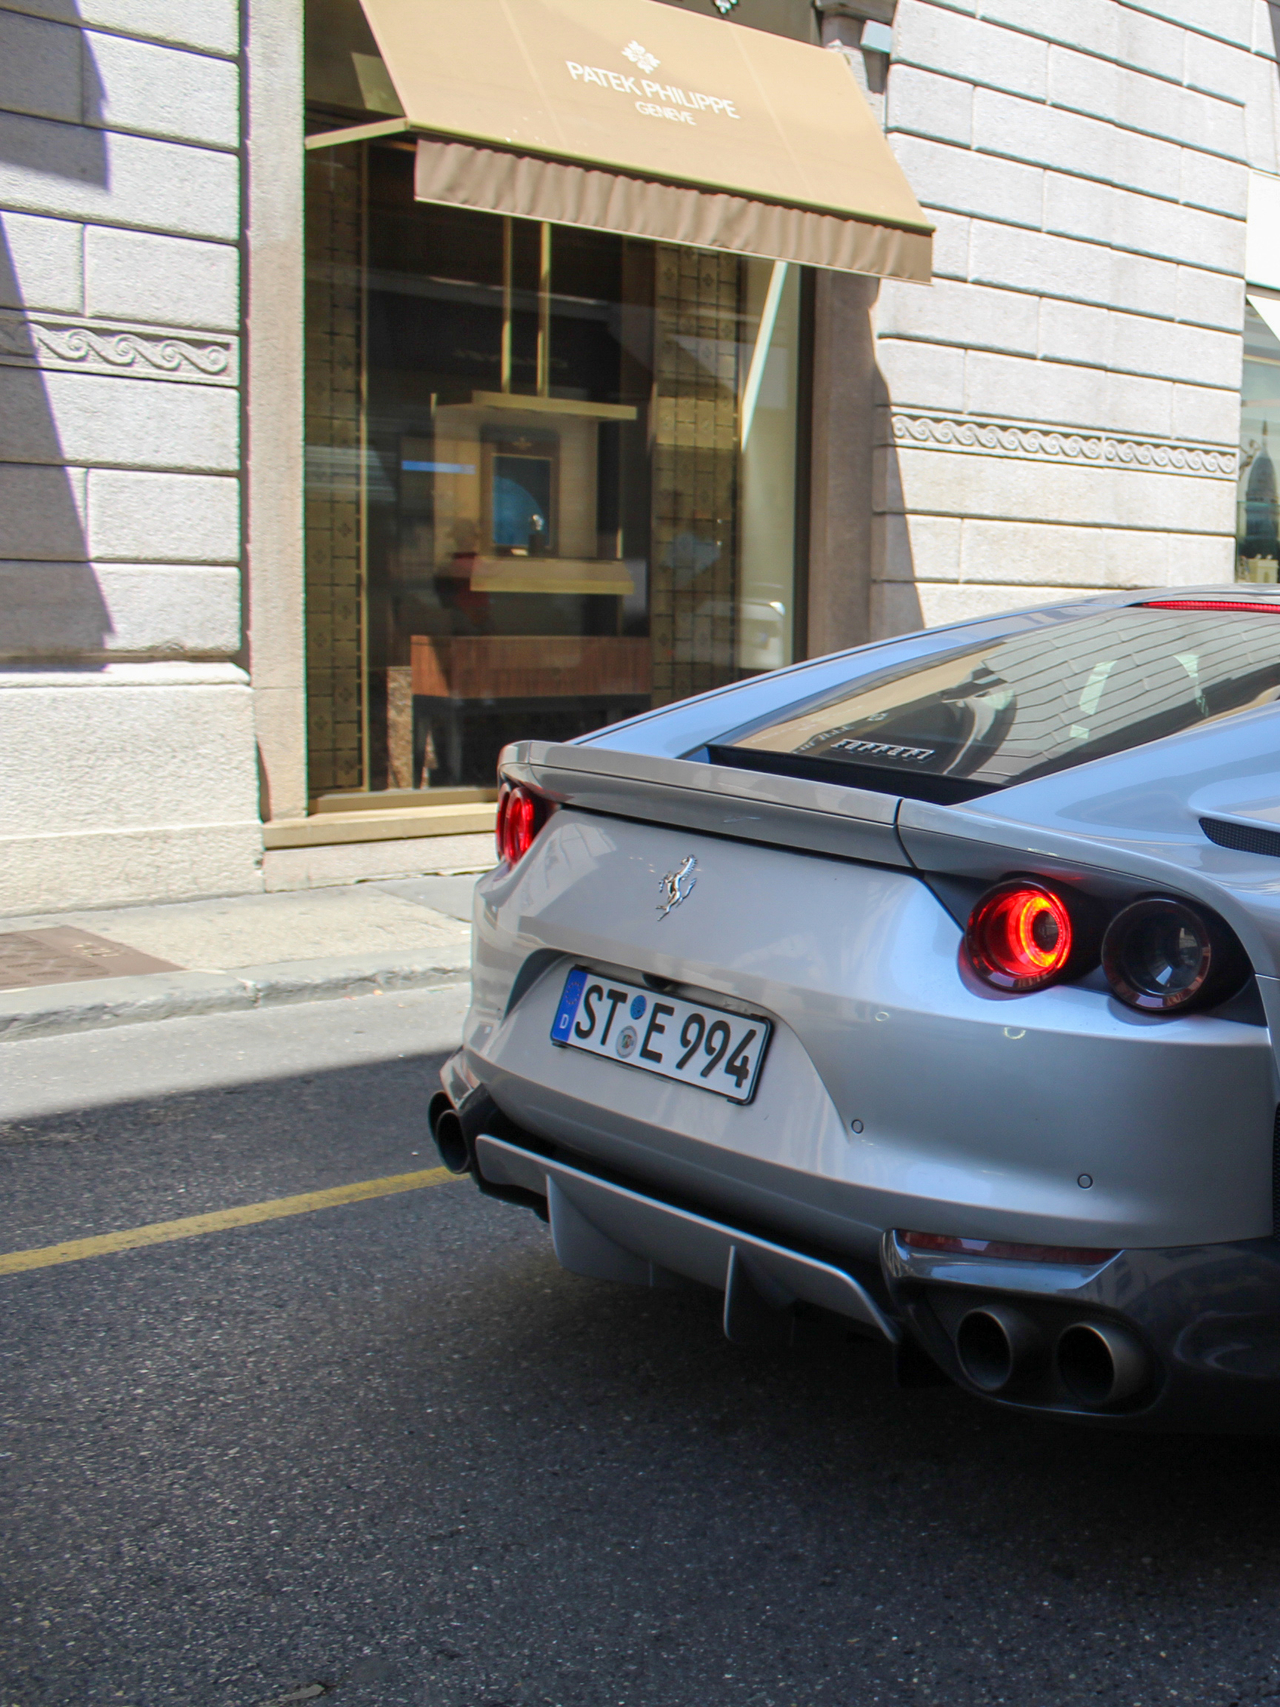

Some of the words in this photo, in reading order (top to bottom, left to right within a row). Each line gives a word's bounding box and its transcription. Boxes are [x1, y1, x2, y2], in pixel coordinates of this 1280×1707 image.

[565, 60, 642, 96] PATEK
[640, 79, 741, 119] PHILIPPE
[635, 101, 697, 126] GENEVE
[831, 738, 935, 760] Ferrari
[559, 1014, 569, 1029] D
[574, 984, 628, 1046] ST
[639, 1002, 675, 1063] E
[675, 1013, 757, 1089] 994
